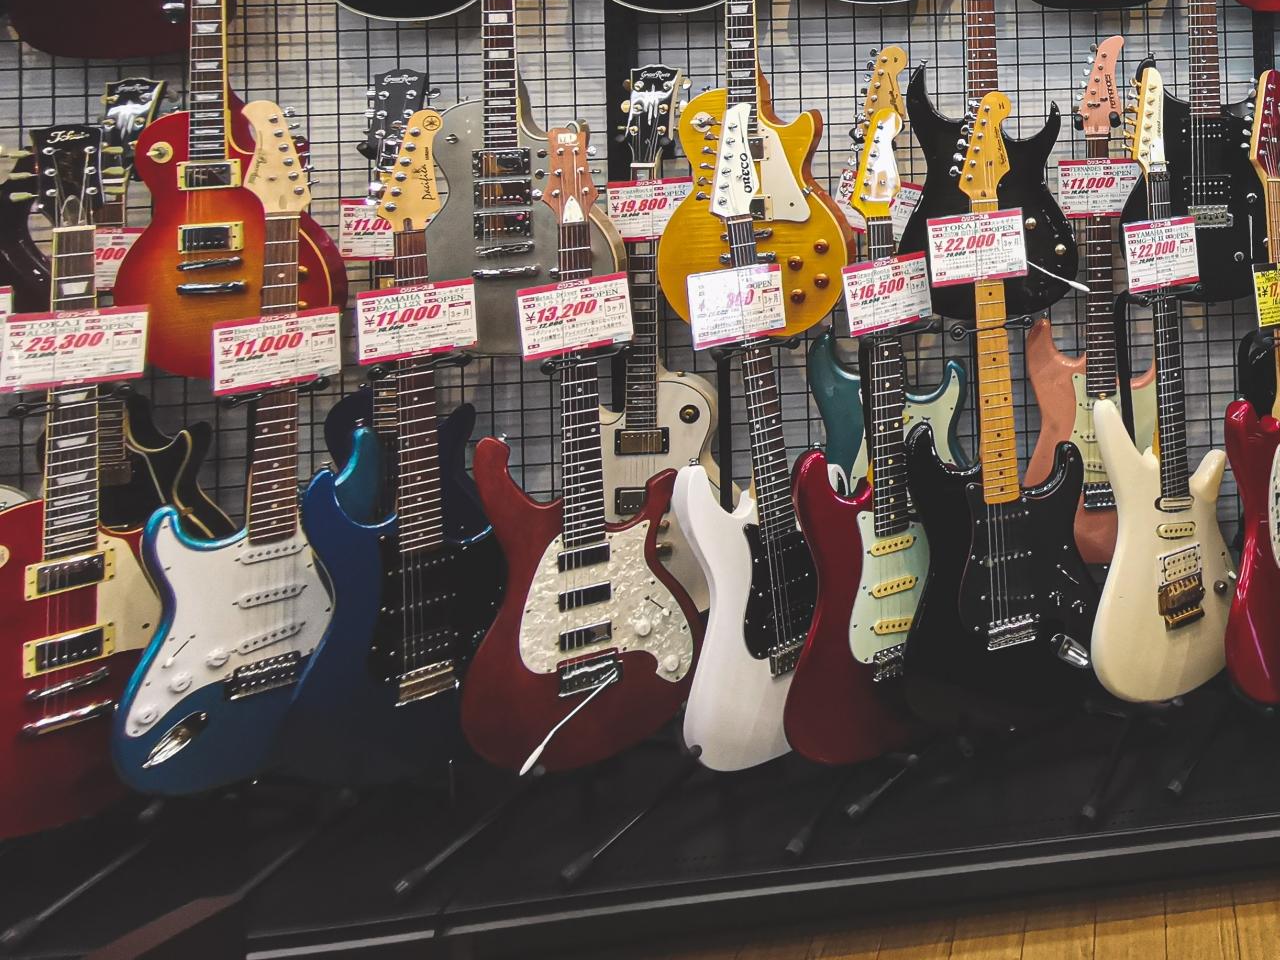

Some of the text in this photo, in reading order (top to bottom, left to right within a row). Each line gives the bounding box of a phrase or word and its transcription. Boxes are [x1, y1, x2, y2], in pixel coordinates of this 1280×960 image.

[420, 164, 437, 201] Pacifica
[1062, 176, 1116, 190] ¥11,000
[664, 189, 686, 197] OPEN
[611, 198, 667, 212] ¥19,800
[942, 221, 977, 232] TOKAI
[991, 224, 1014, 232] OPEN
[1136, 227, 1164, 239] YAMAHA
[1173, 232, 1190, 240] OPEN
[934, 233, 995, 253] ¥22,000
[1130, 240, 1176, 259] ¥22,000
[752, 279, 772, 290] OPEN
[850, 277, 905, 301] ¥16,500
[376, 293, 421, 305] YAMAHA
[436, 294, 464, 304] OPEN
[593, 288, 619, 298] OPEN
[364, 304, 442, 327] ¥11,000
[526, 299, 598, 324] ¥13,200
[26, 319, 81, 330] TOKAI
[101, 321, 134, 332] OPEN
[11, 331, 105, 352] ¥25,300
[222, 331, 304, 357] ¥11,000
